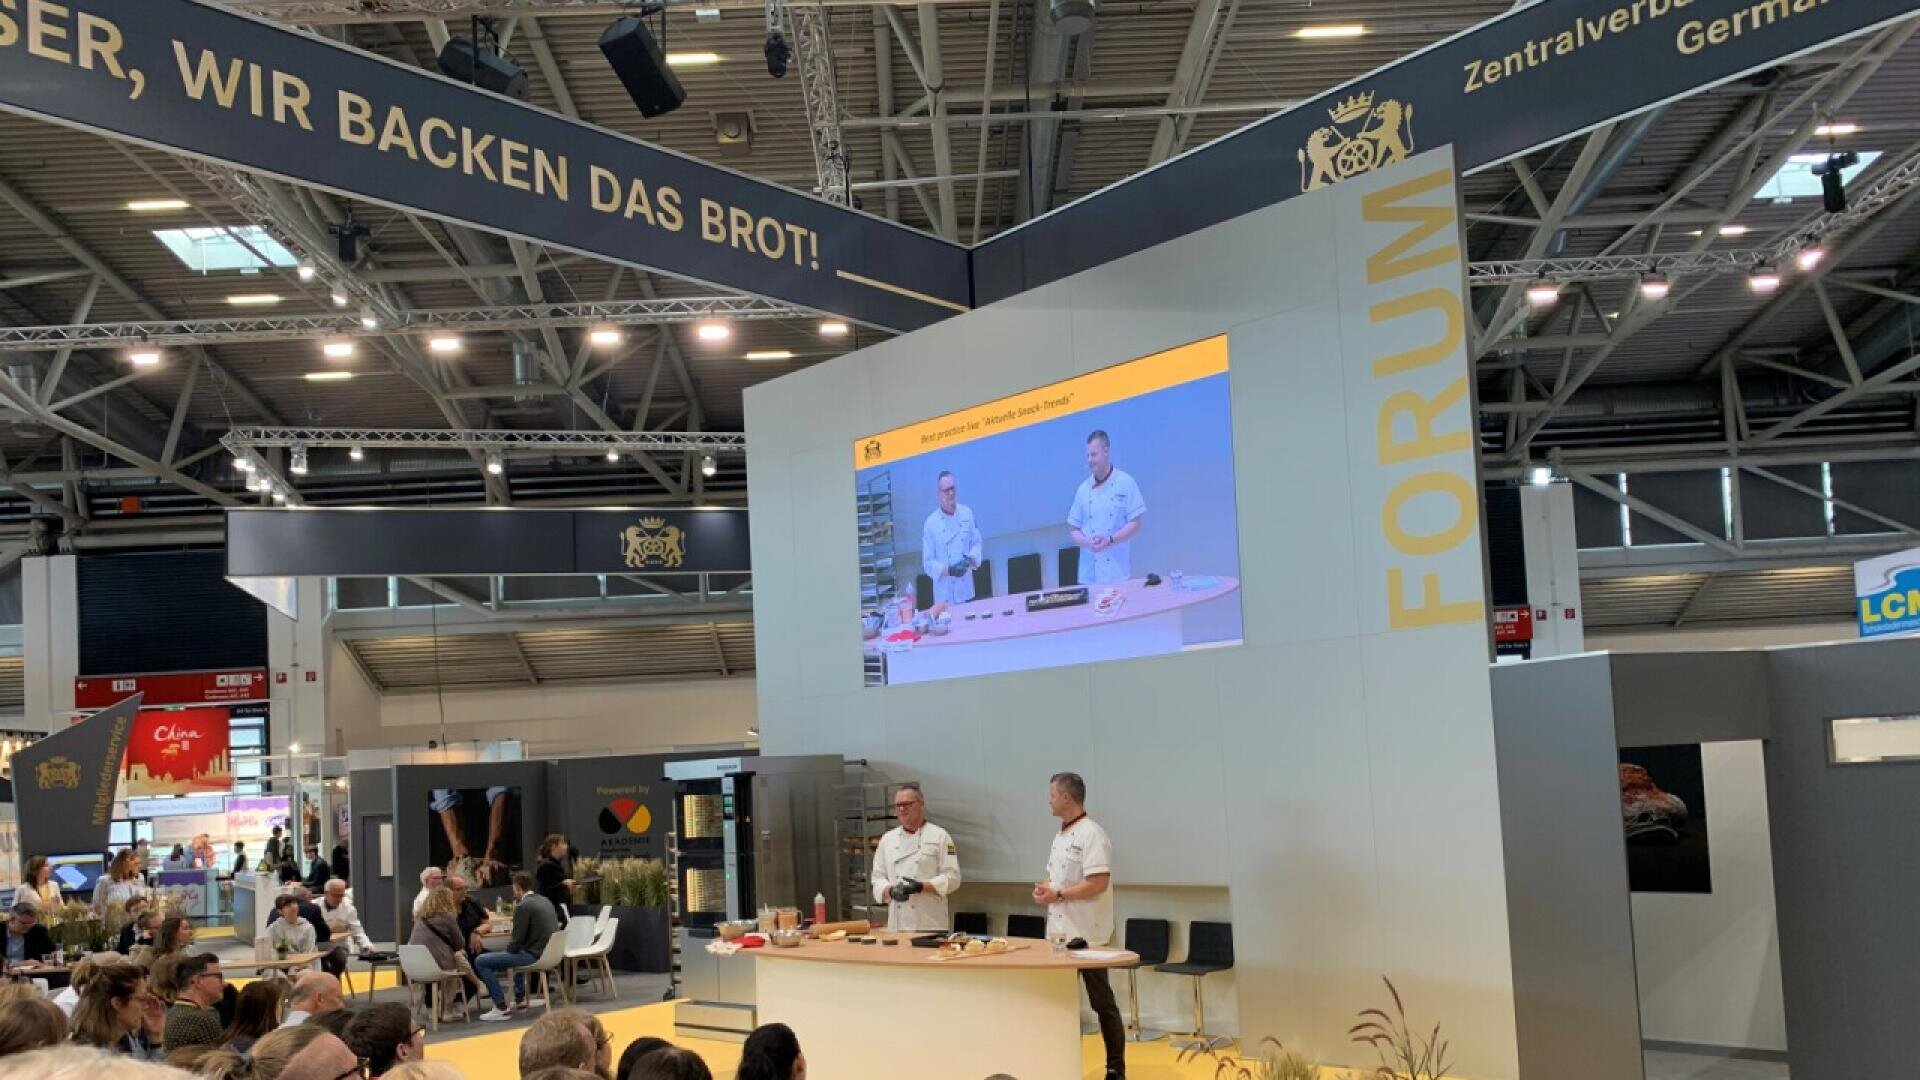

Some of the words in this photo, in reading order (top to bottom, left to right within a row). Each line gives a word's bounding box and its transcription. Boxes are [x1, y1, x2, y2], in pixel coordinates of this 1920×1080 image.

[173, 39, 314, 131] WIR
[338, 90, 568, 201] BACKEN
[590, 165, 684, 231] DAS
[701, 198, 820, 270] BROT!
[1362, 166, 1483, 630] FORUM
[154, 723, 206, 741] China
